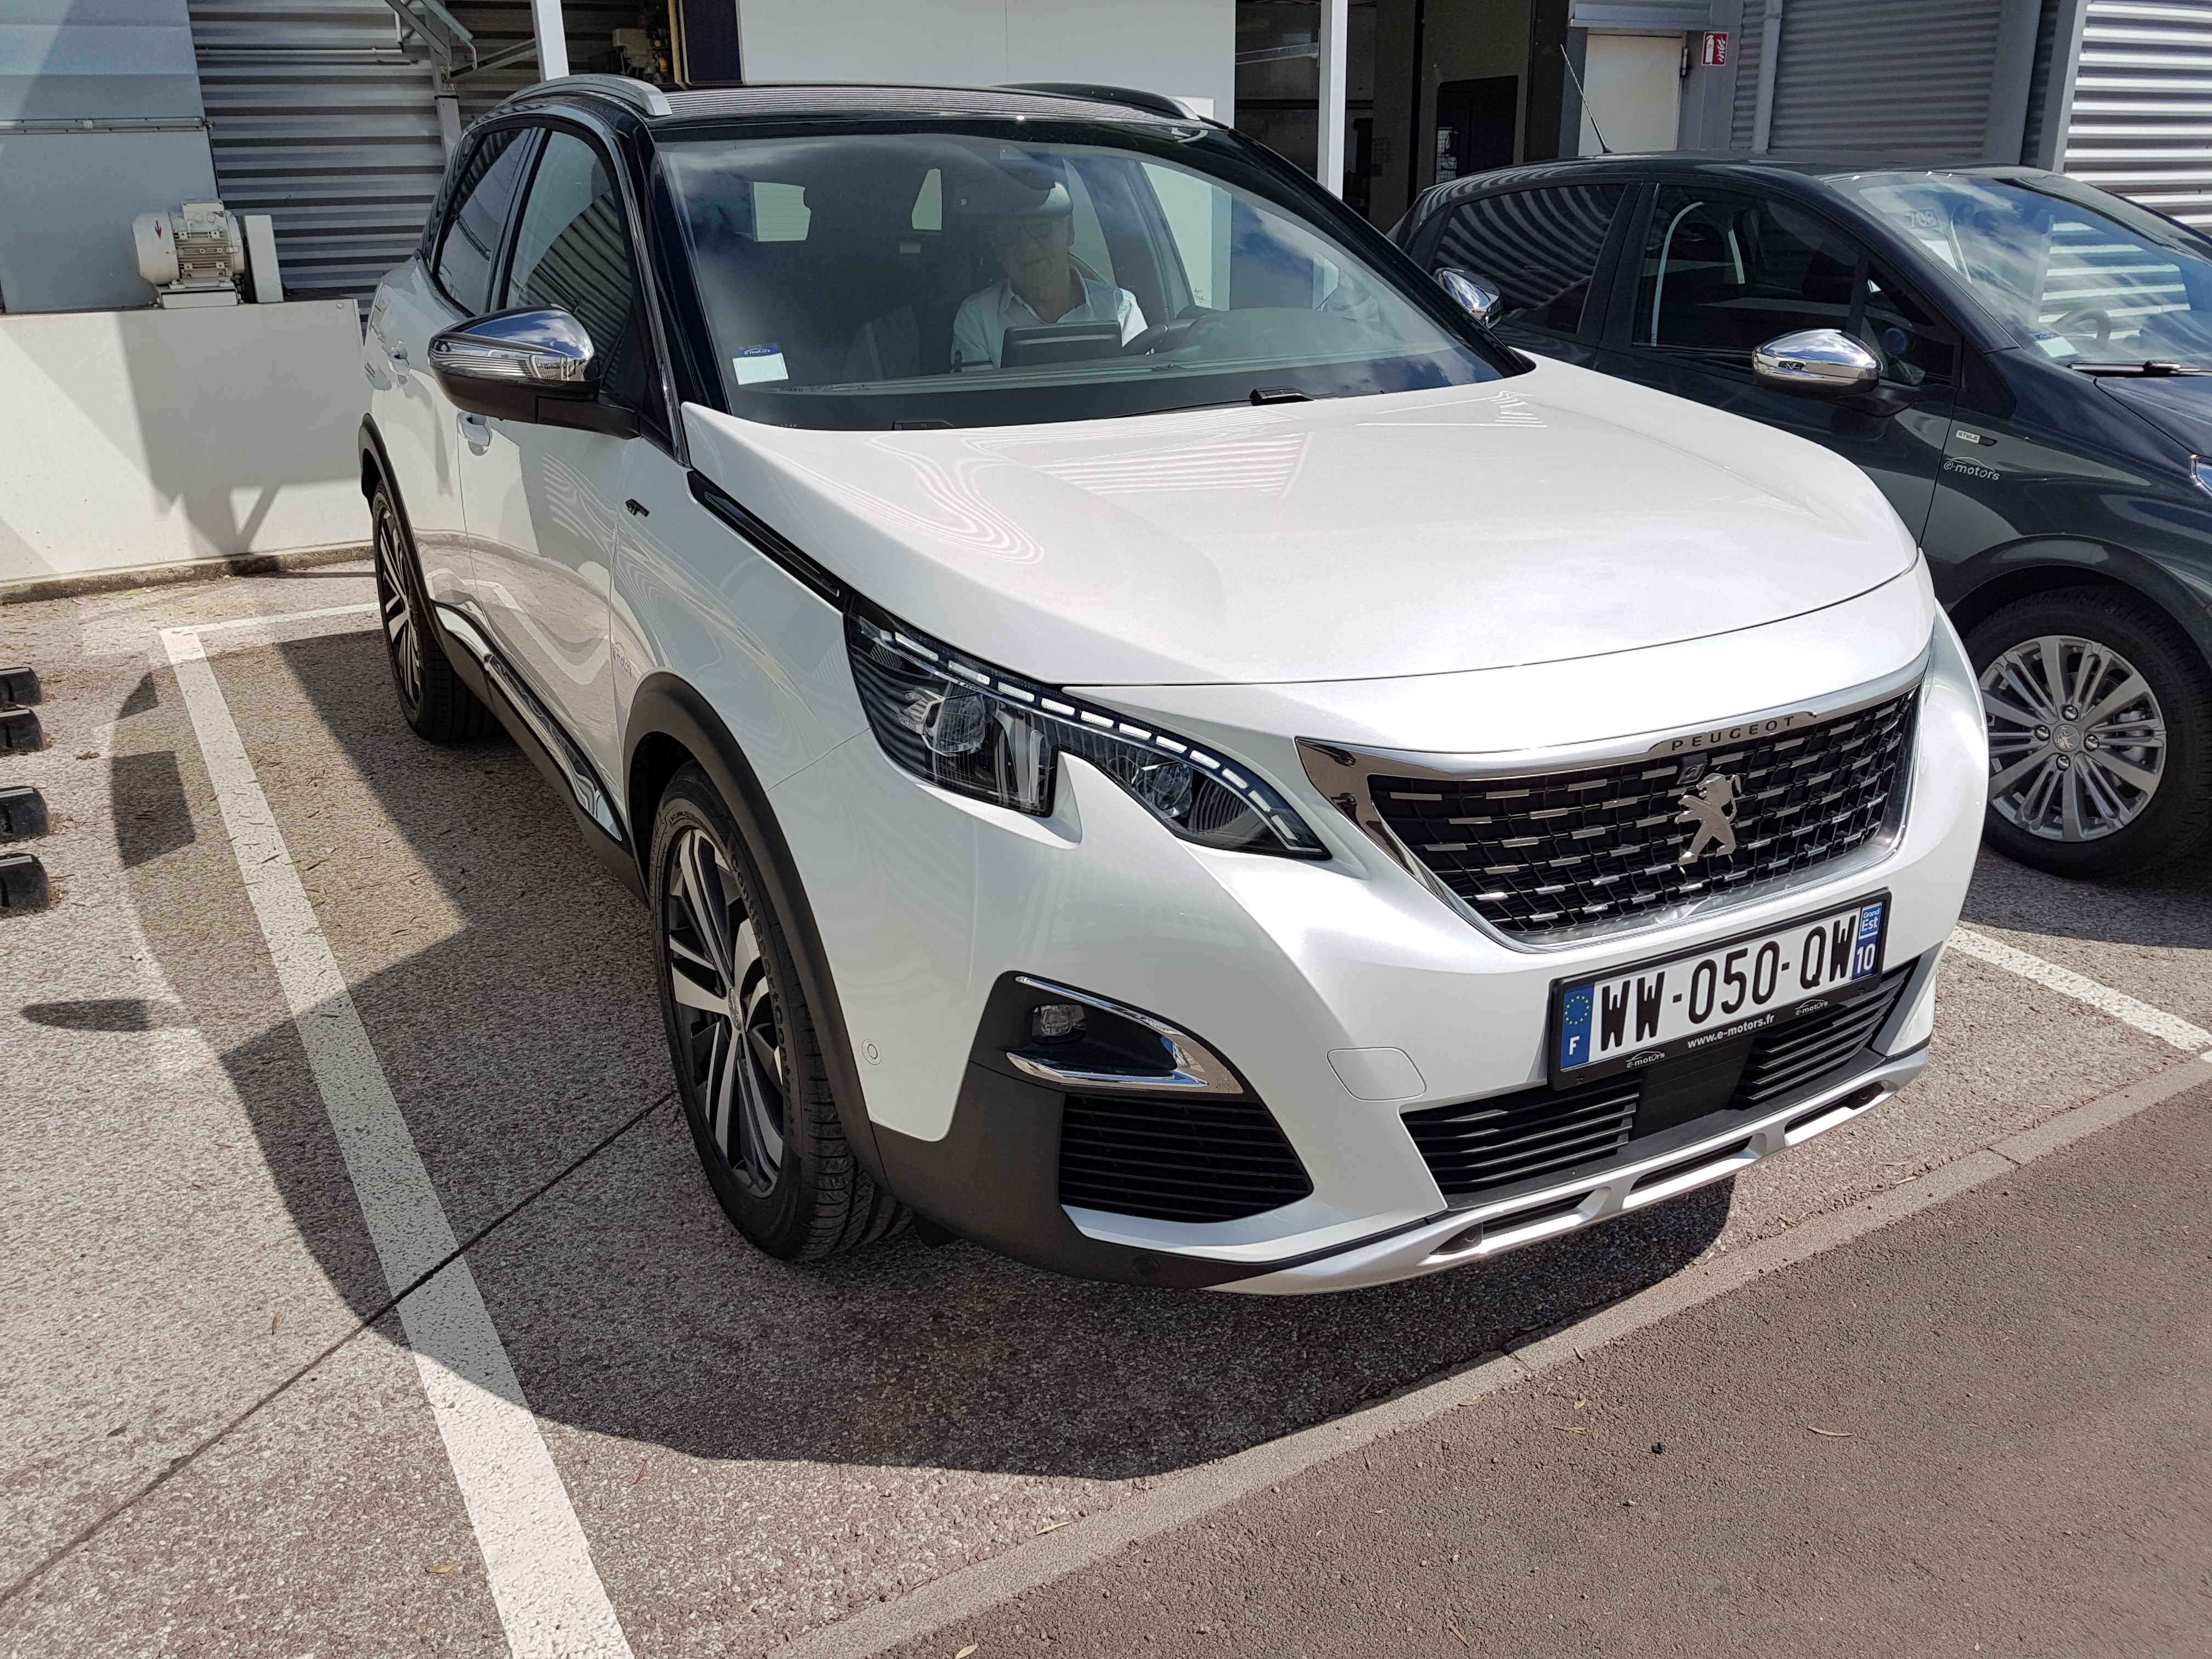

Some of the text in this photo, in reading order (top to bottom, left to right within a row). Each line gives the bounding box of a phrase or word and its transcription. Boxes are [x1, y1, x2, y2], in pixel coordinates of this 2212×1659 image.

[1958, 431, 1978, 441] STYLE
[1944, 461, 2000, 481] e-motors
[1671, 715, 1795, 751] PEUGEOT
[1863, 907, 1881, 919] Grand
[1861, 916, 1879, 933] Est
[1856, 943, 1876, 974] 10
[1795, 999, 1829, 1016] e-motors
[1687, 1013, 1775, 1049] www.e-motors.fr
[1568, 1035, 1580, 1056] F
[1626, 1052, 1666, 1069] e-motors
